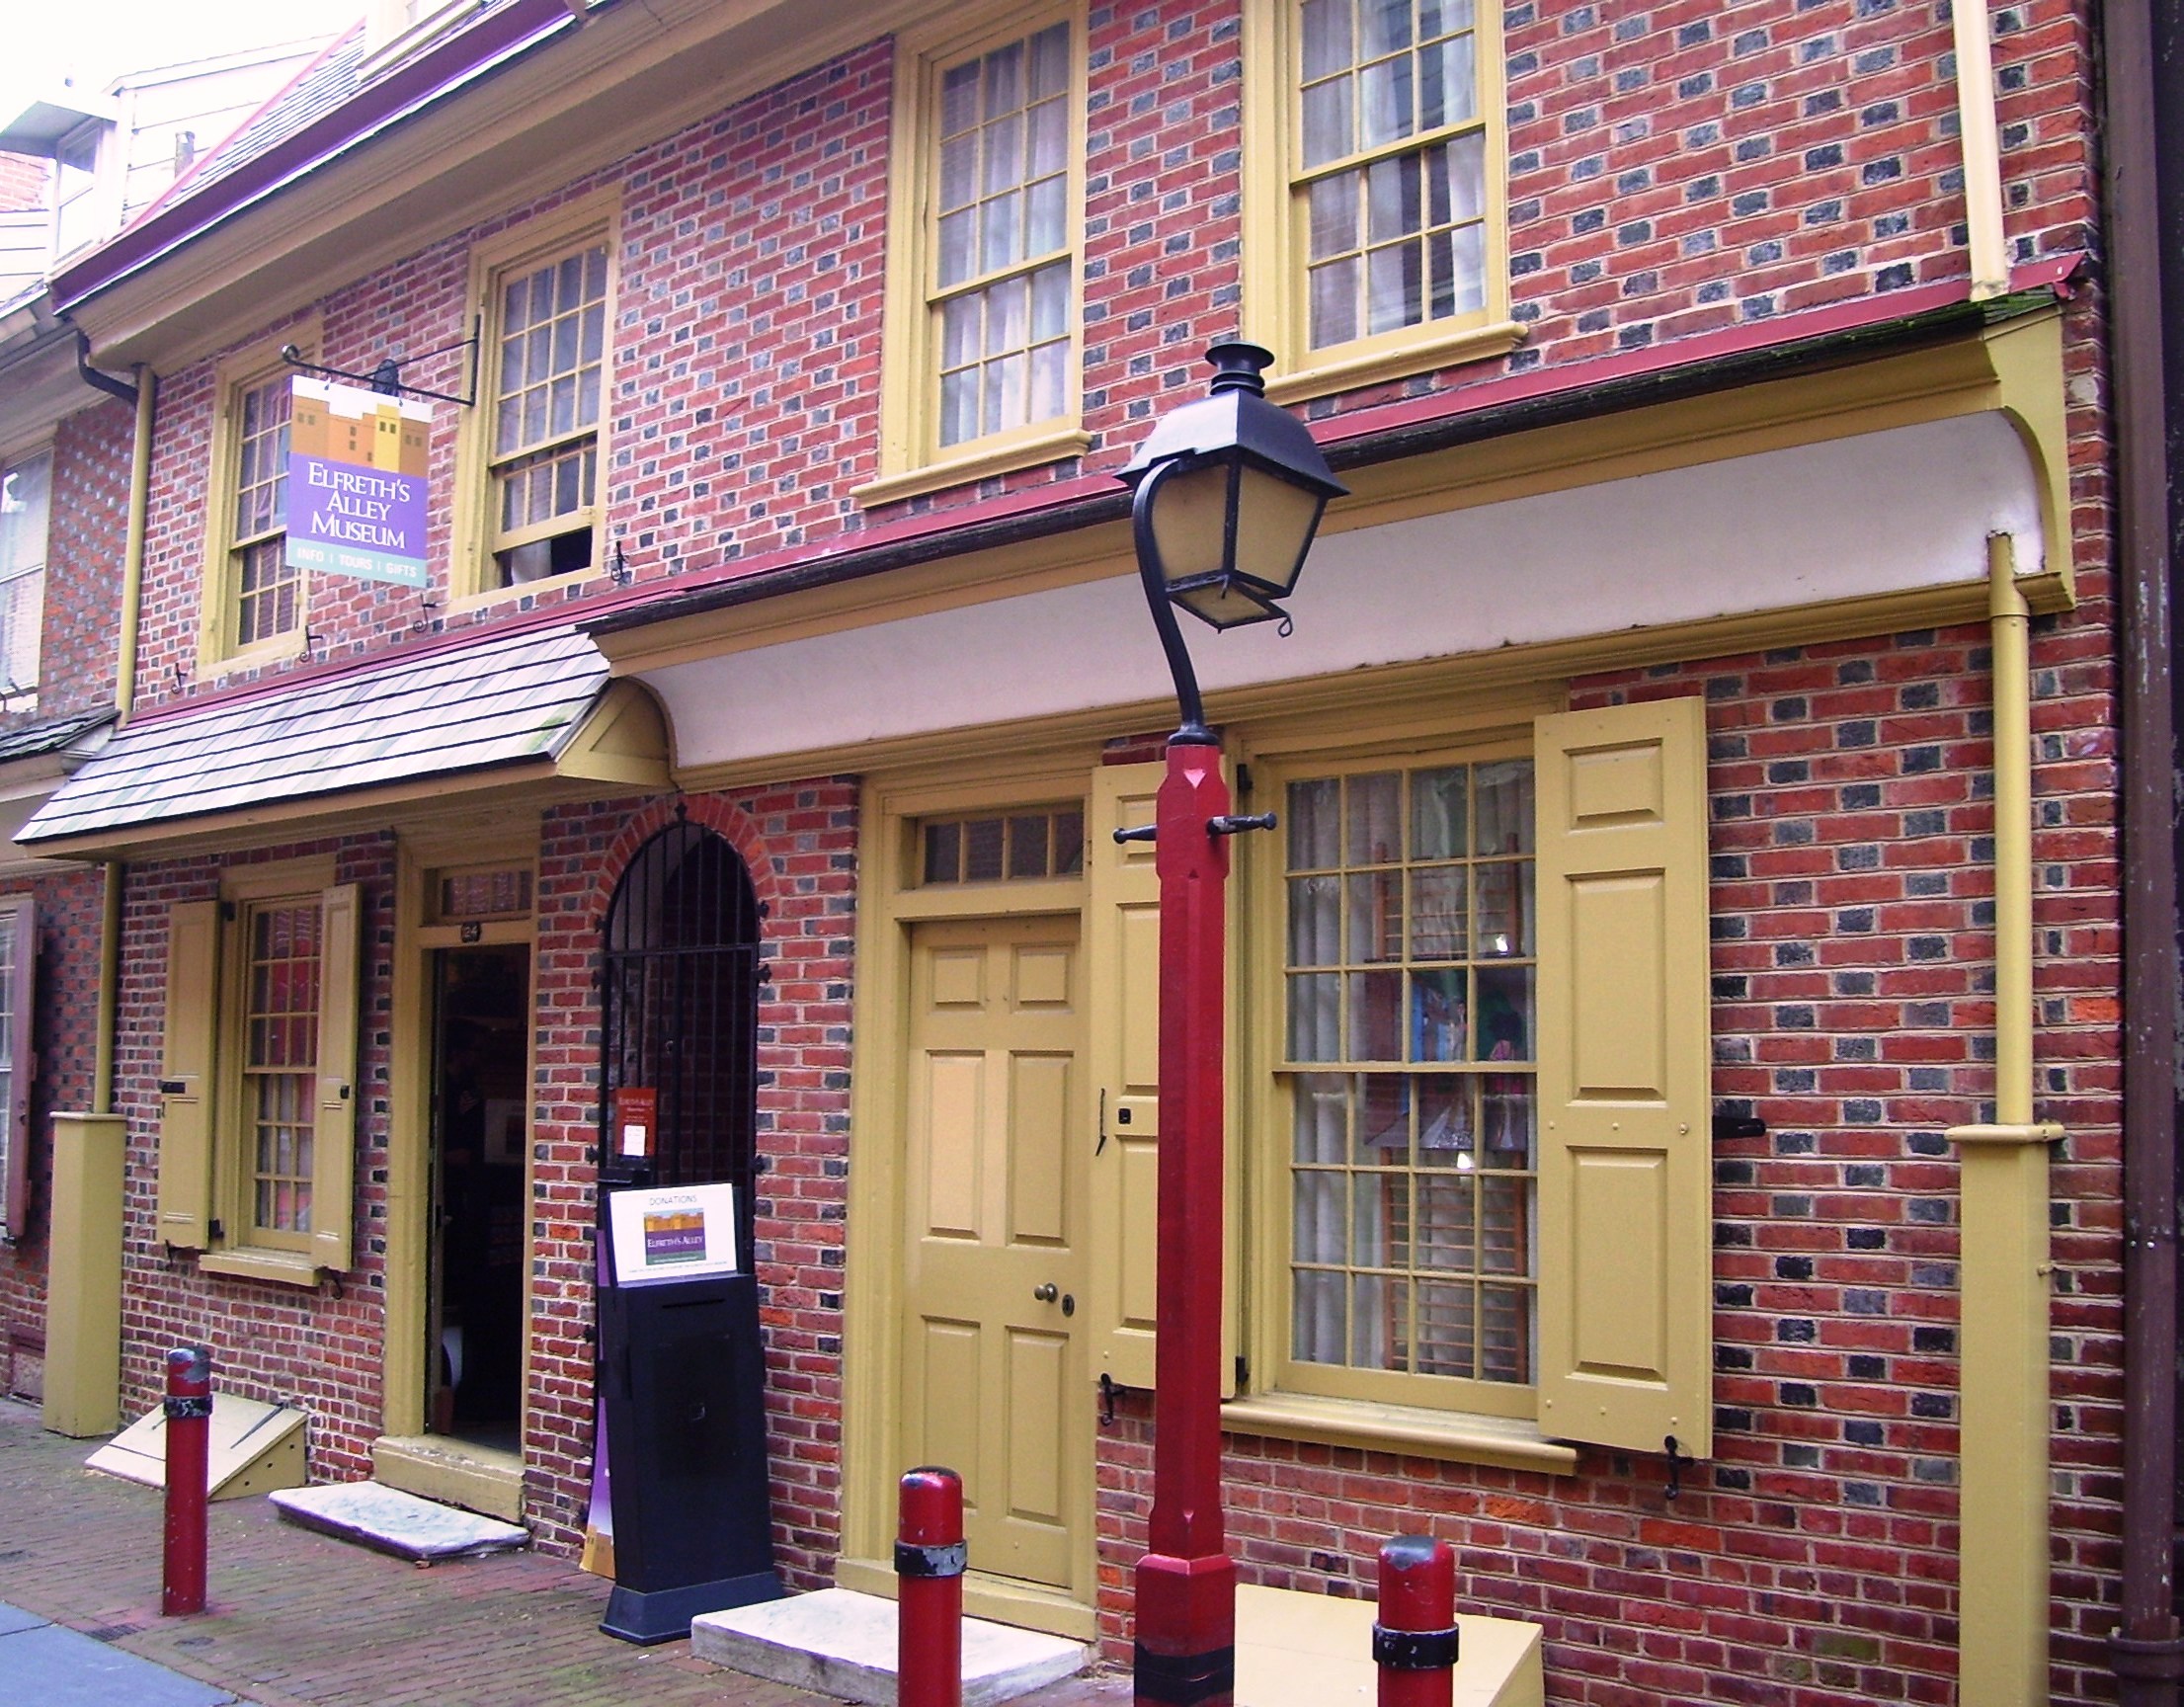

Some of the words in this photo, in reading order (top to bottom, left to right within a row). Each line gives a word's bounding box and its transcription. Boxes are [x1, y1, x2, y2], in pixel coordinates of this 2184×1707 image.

[308, 461, 410, 502] ELFRETH'S
[326, 490, 391, 522] ALLEY
[310, 511, 405, 549] MUSEUM
[297, 547, 324, 562] INFO
[339, 555, 372, 570] TOURS
[386, 562, 418, 578] GIFTS
[649, 1194, 696, 1206] DONATIONS
